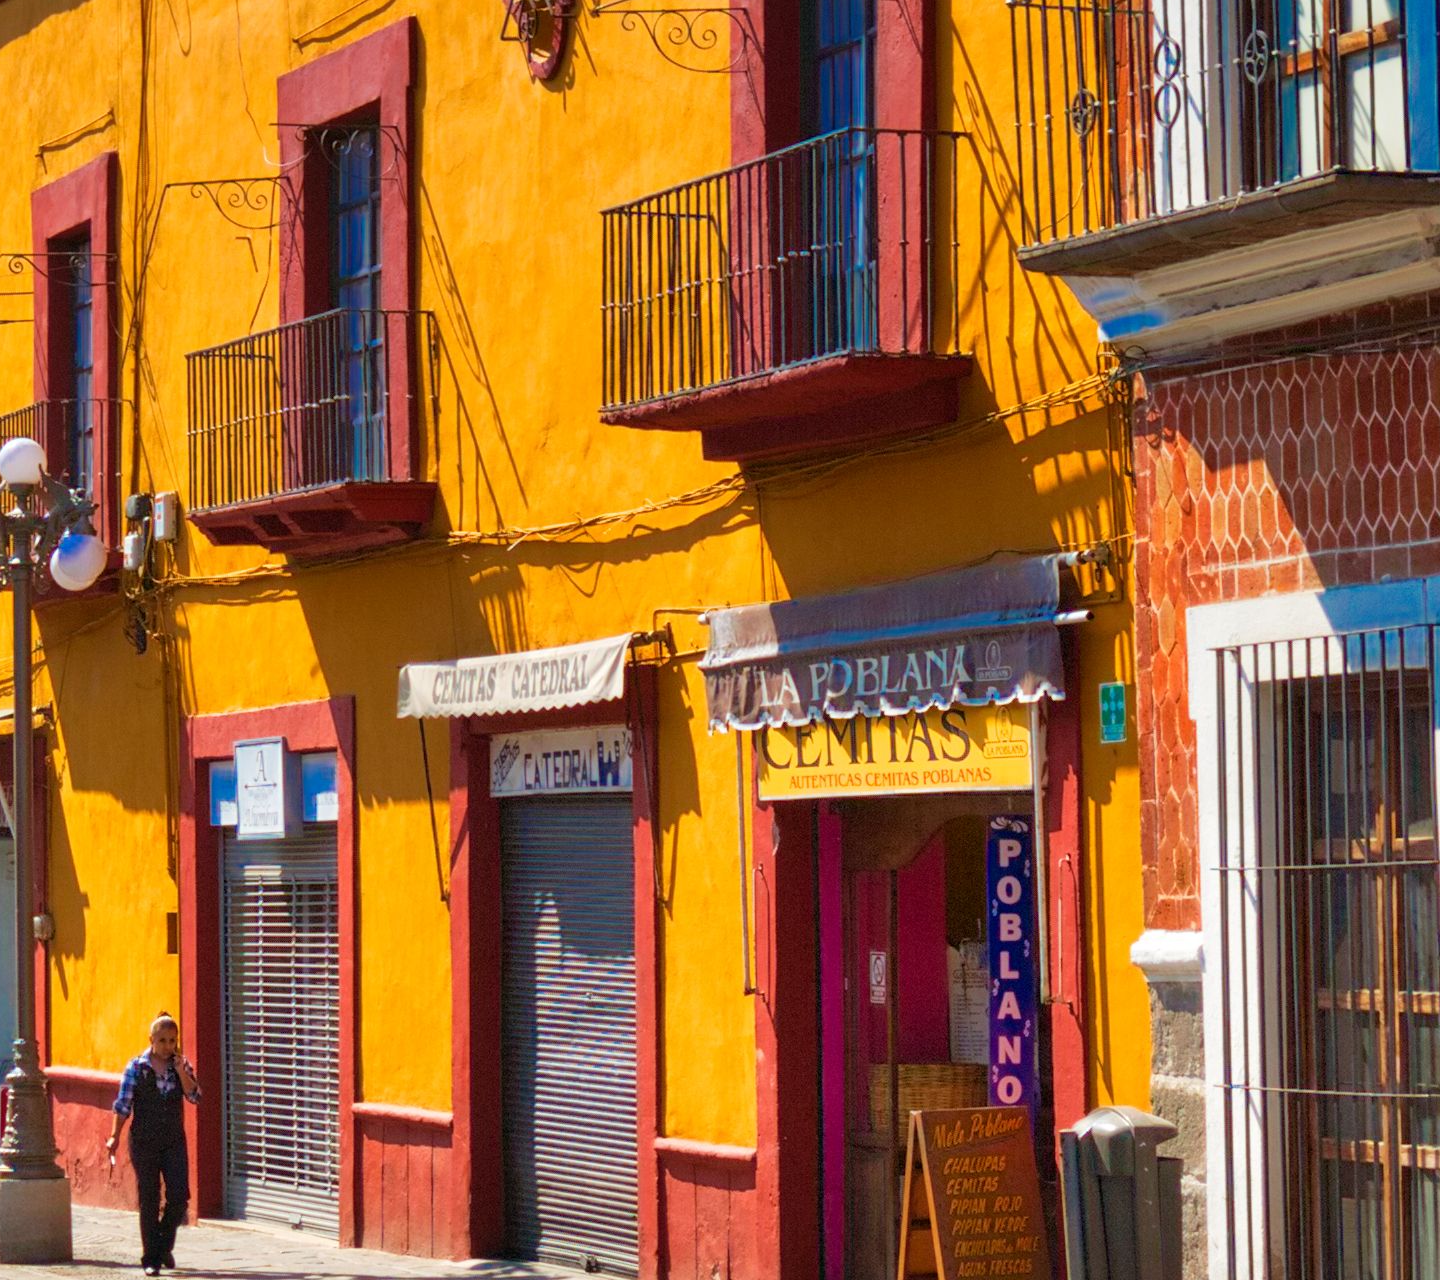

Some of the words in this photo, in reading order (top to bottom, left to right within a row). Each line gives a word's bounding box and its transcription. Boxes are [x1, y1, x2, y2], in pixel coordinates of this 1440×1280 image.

[432, 664, 497, 705] CEMITAS
[511, 654, 591, 700] CATEDRAL
[759, 668, 801, 707] LA
[809, 644, 973, 701] POBLANA
[760, 708, 971, 770] CEMITAS
[524, 748, 598, 791] CATEDRAL
[789, 772, 863, 789] AUTENTICAS
[866, 770, 919, 787] CEMITAS
[922, 767, 993, 786] POBLANAS
[996, 839, 1023, 1105] POBLANO
[932, 1121, 965, 1149] Mole
[968, 1111, 1024, 1141] Poblano
[943, 1155, 1007, 1176] CHALUPAS
[946, 1176, 1000, 1195] CEMITAS
[949, 1198, 987, 1215] PIPIAN
[993, 1195, 1023, 1213] ROJO
[951, 1218, 992, 1236] PIPIAN
[994, 1216, 1031, 1233] VERDE
[957, 1261, 986, 1277] AGUAS
[989, 1258, 1033, 1276] FRESCAS
